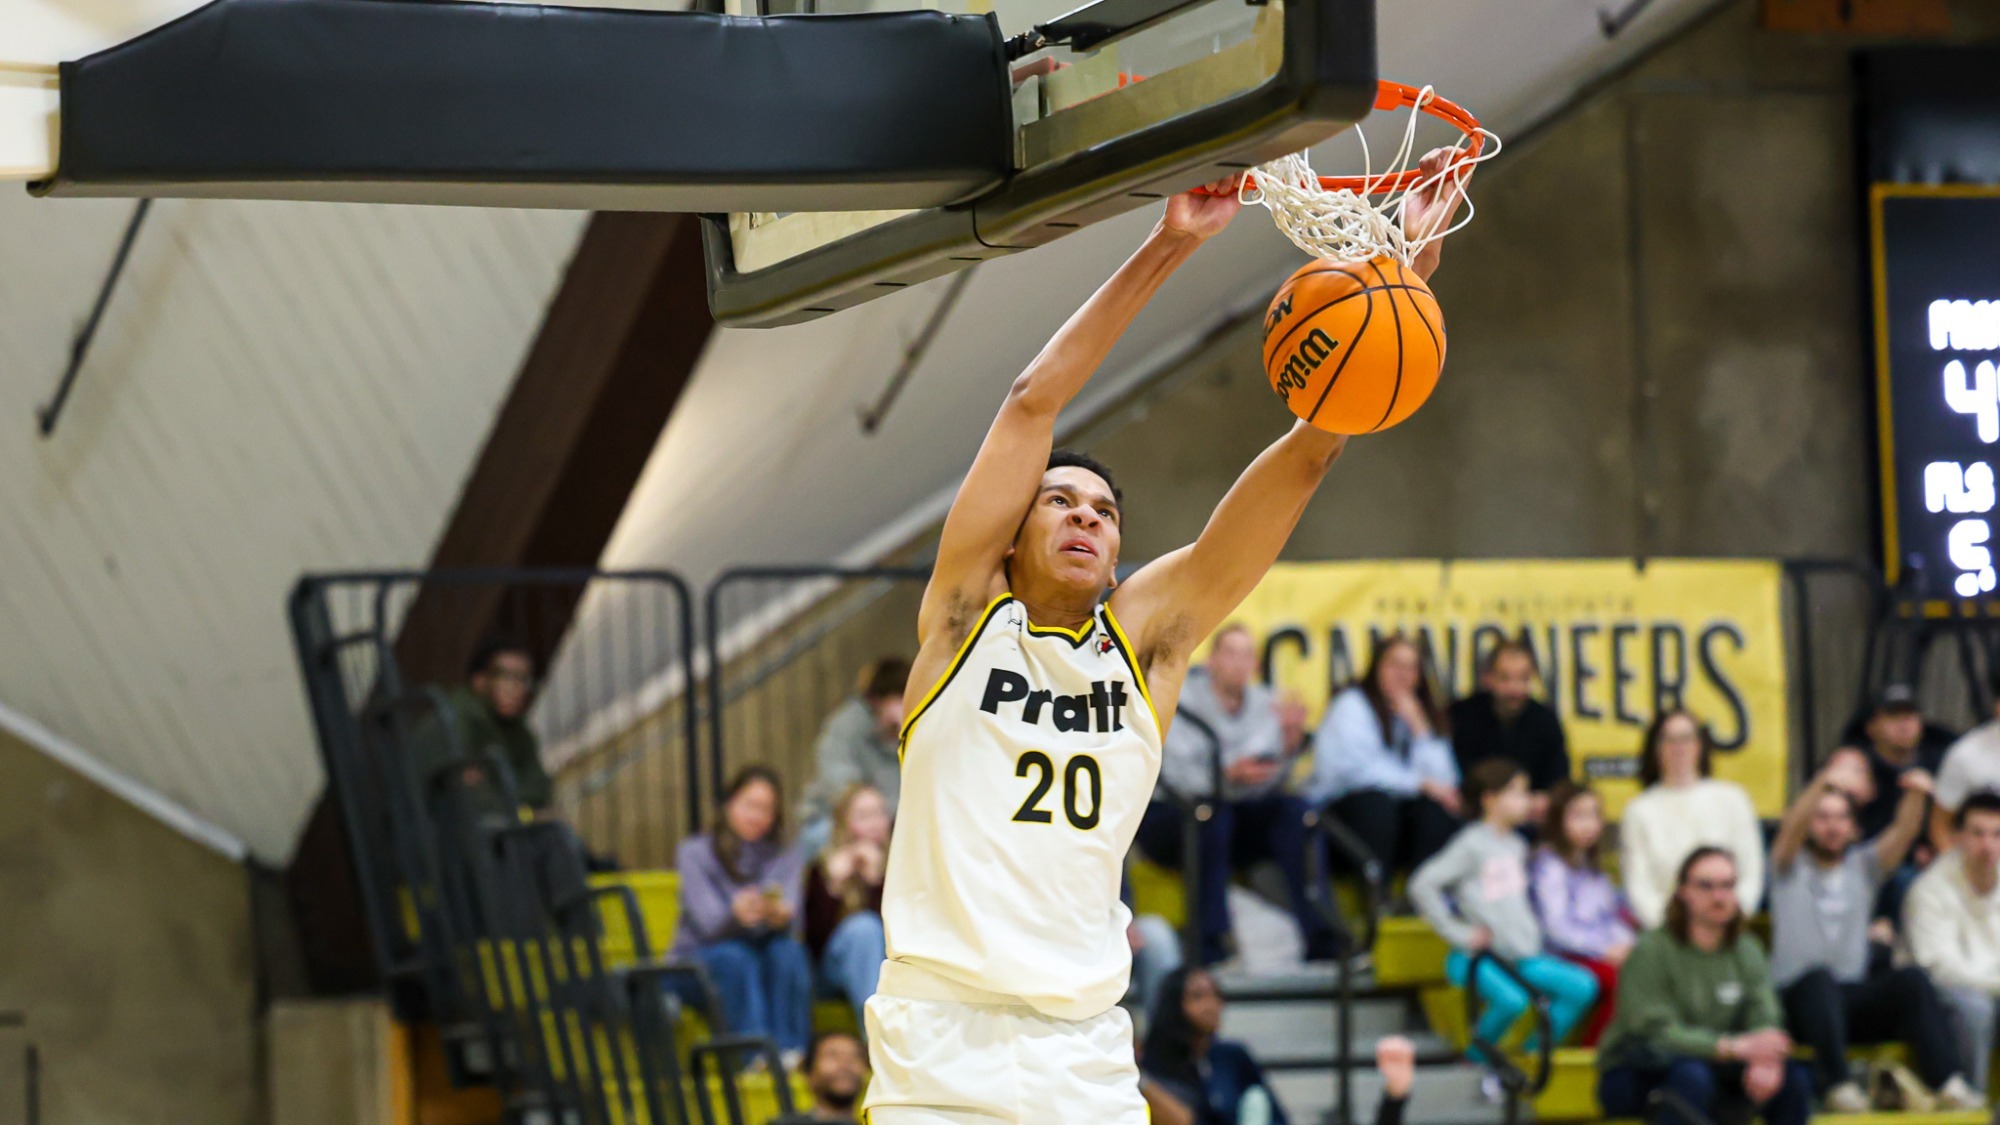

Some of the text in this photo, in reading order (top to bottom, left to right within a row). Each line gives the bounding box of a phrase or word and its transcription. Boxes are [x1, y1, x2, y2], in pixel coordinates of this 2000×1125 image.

[1276, 327, 1340, 404] Wilso
[1943, 359, 2000, 443] 4
[979, 667, 1128, 733] Pratt
[1260, 621, 1750, 752] CANONEERS
[1010, 750, 1102, 831] 20
